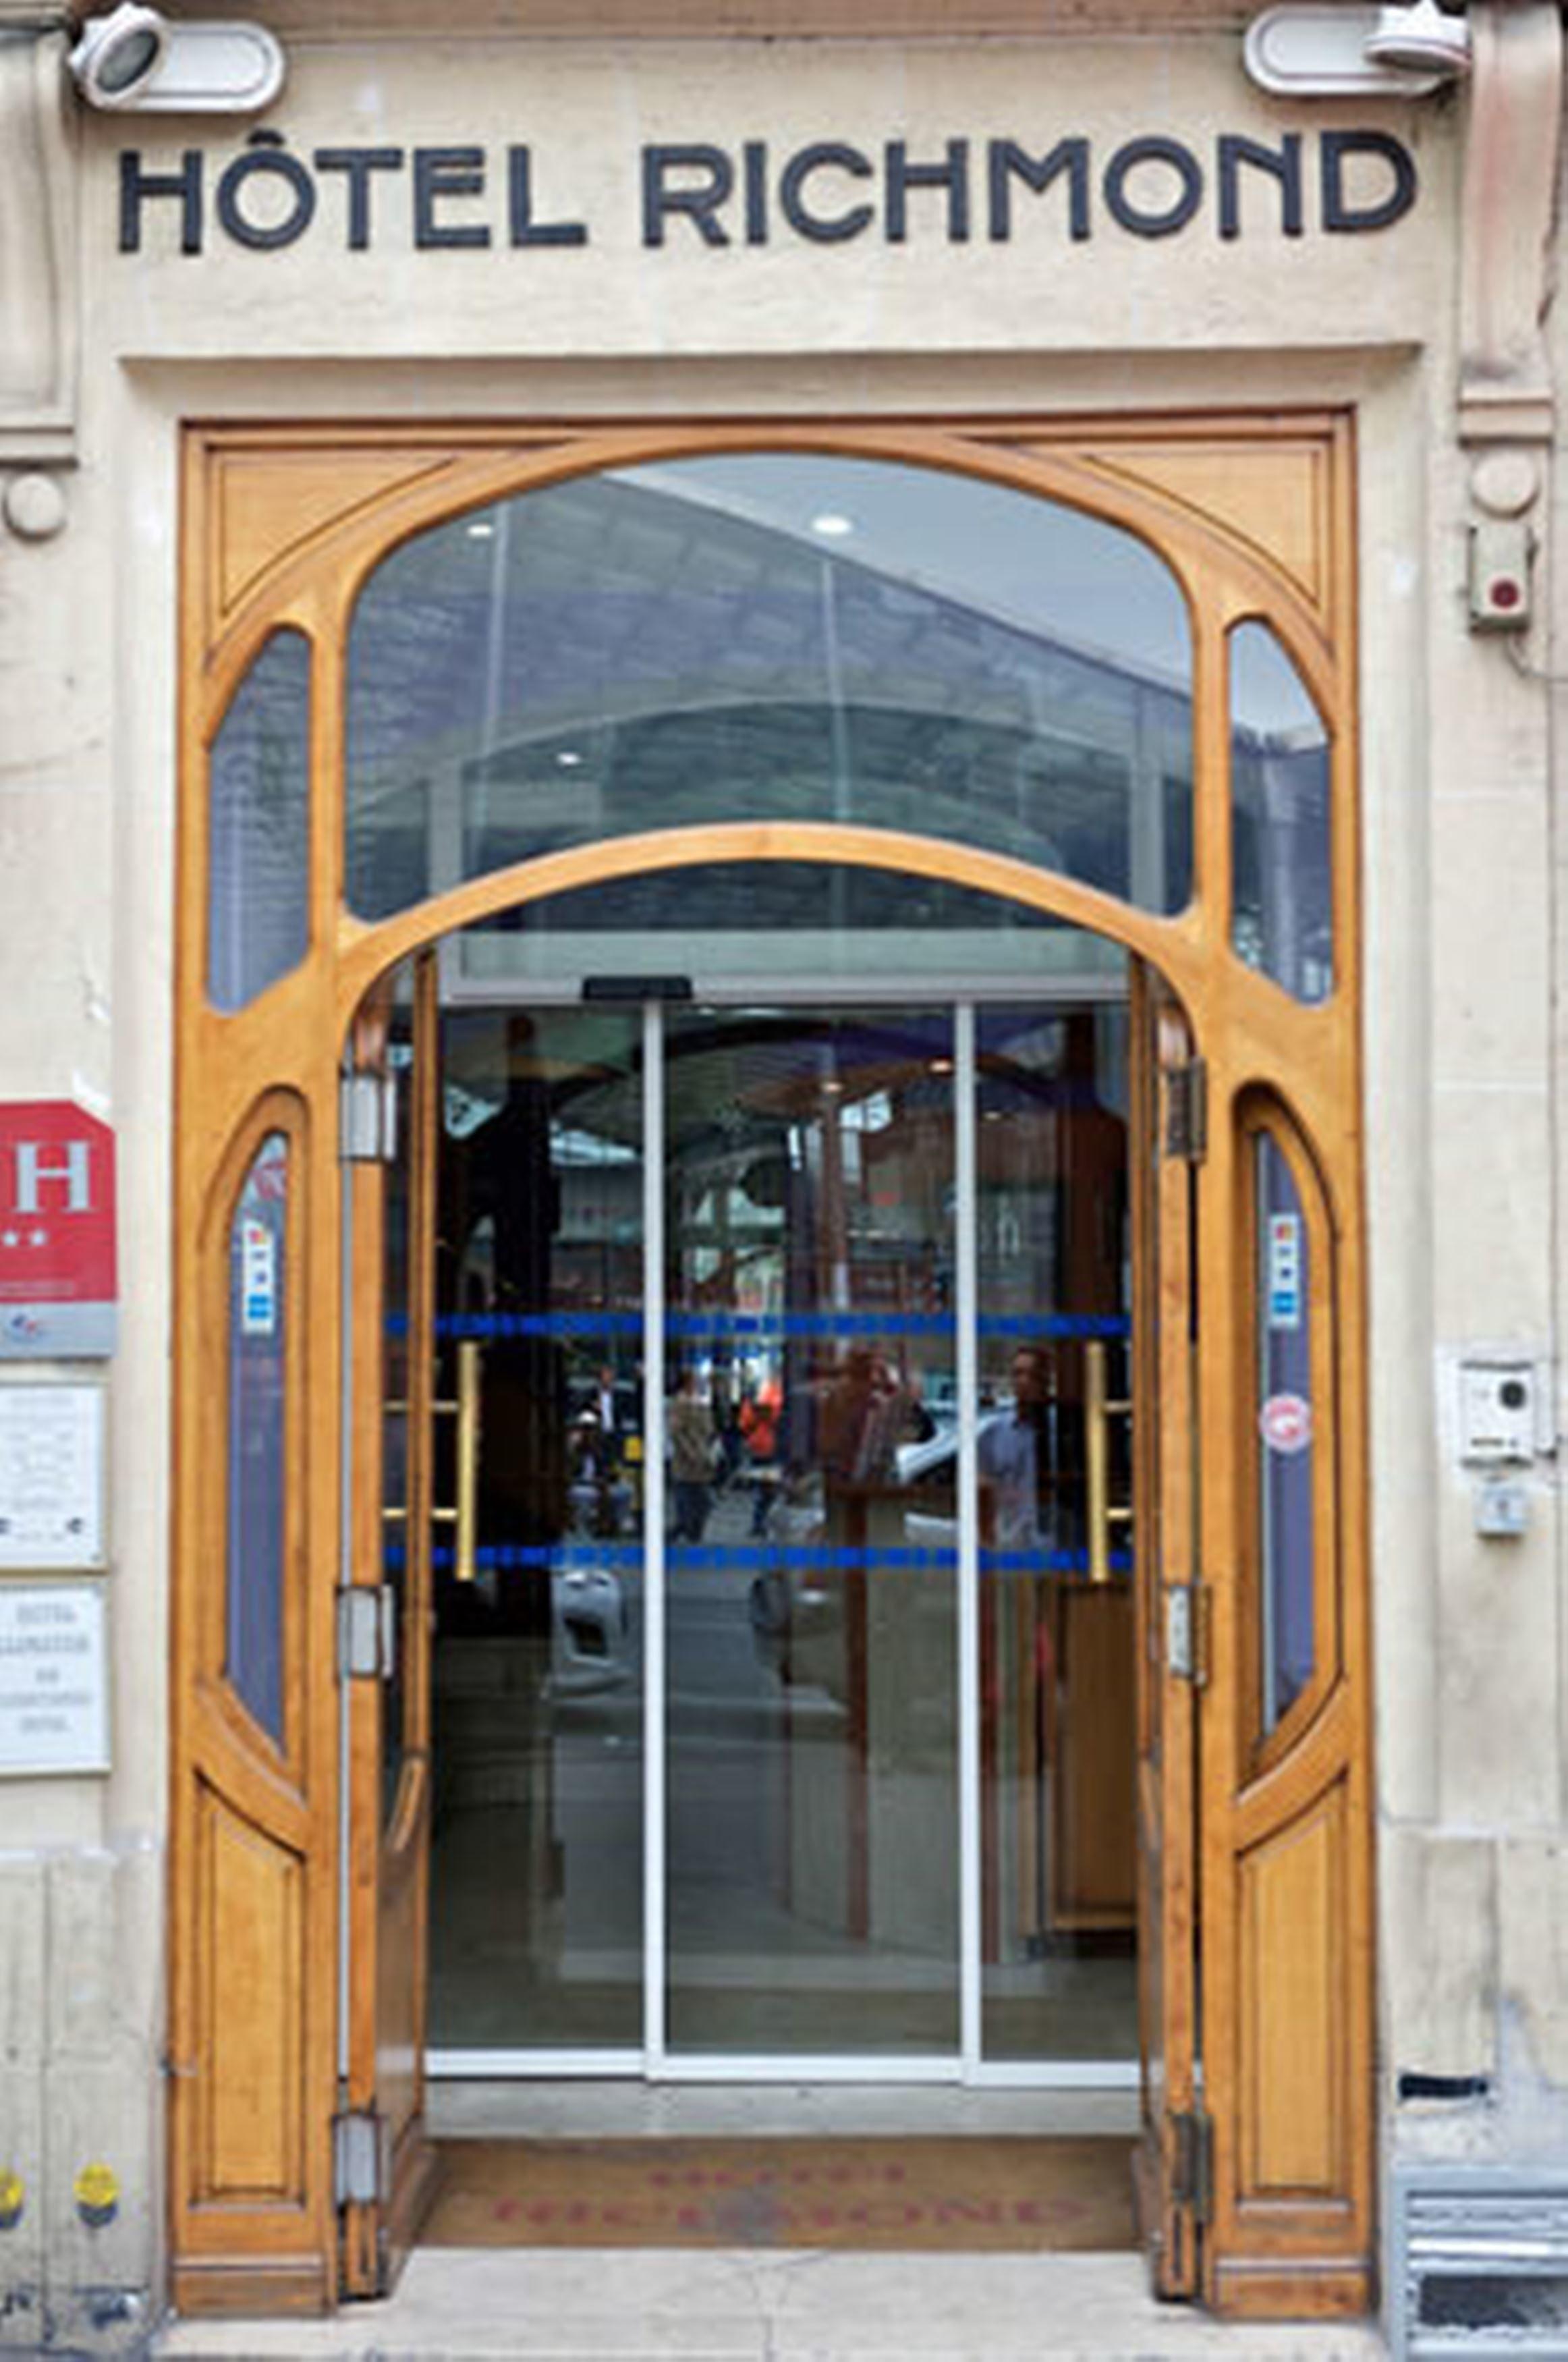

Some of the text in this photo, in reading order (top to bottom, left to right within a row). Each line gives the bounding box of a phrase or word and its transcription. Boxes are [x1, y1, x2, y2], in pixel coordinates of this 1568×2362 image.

[119, 128, 1418, 255] HÔTEL RICHMOND
[15, 1140, 93, 1213] H
